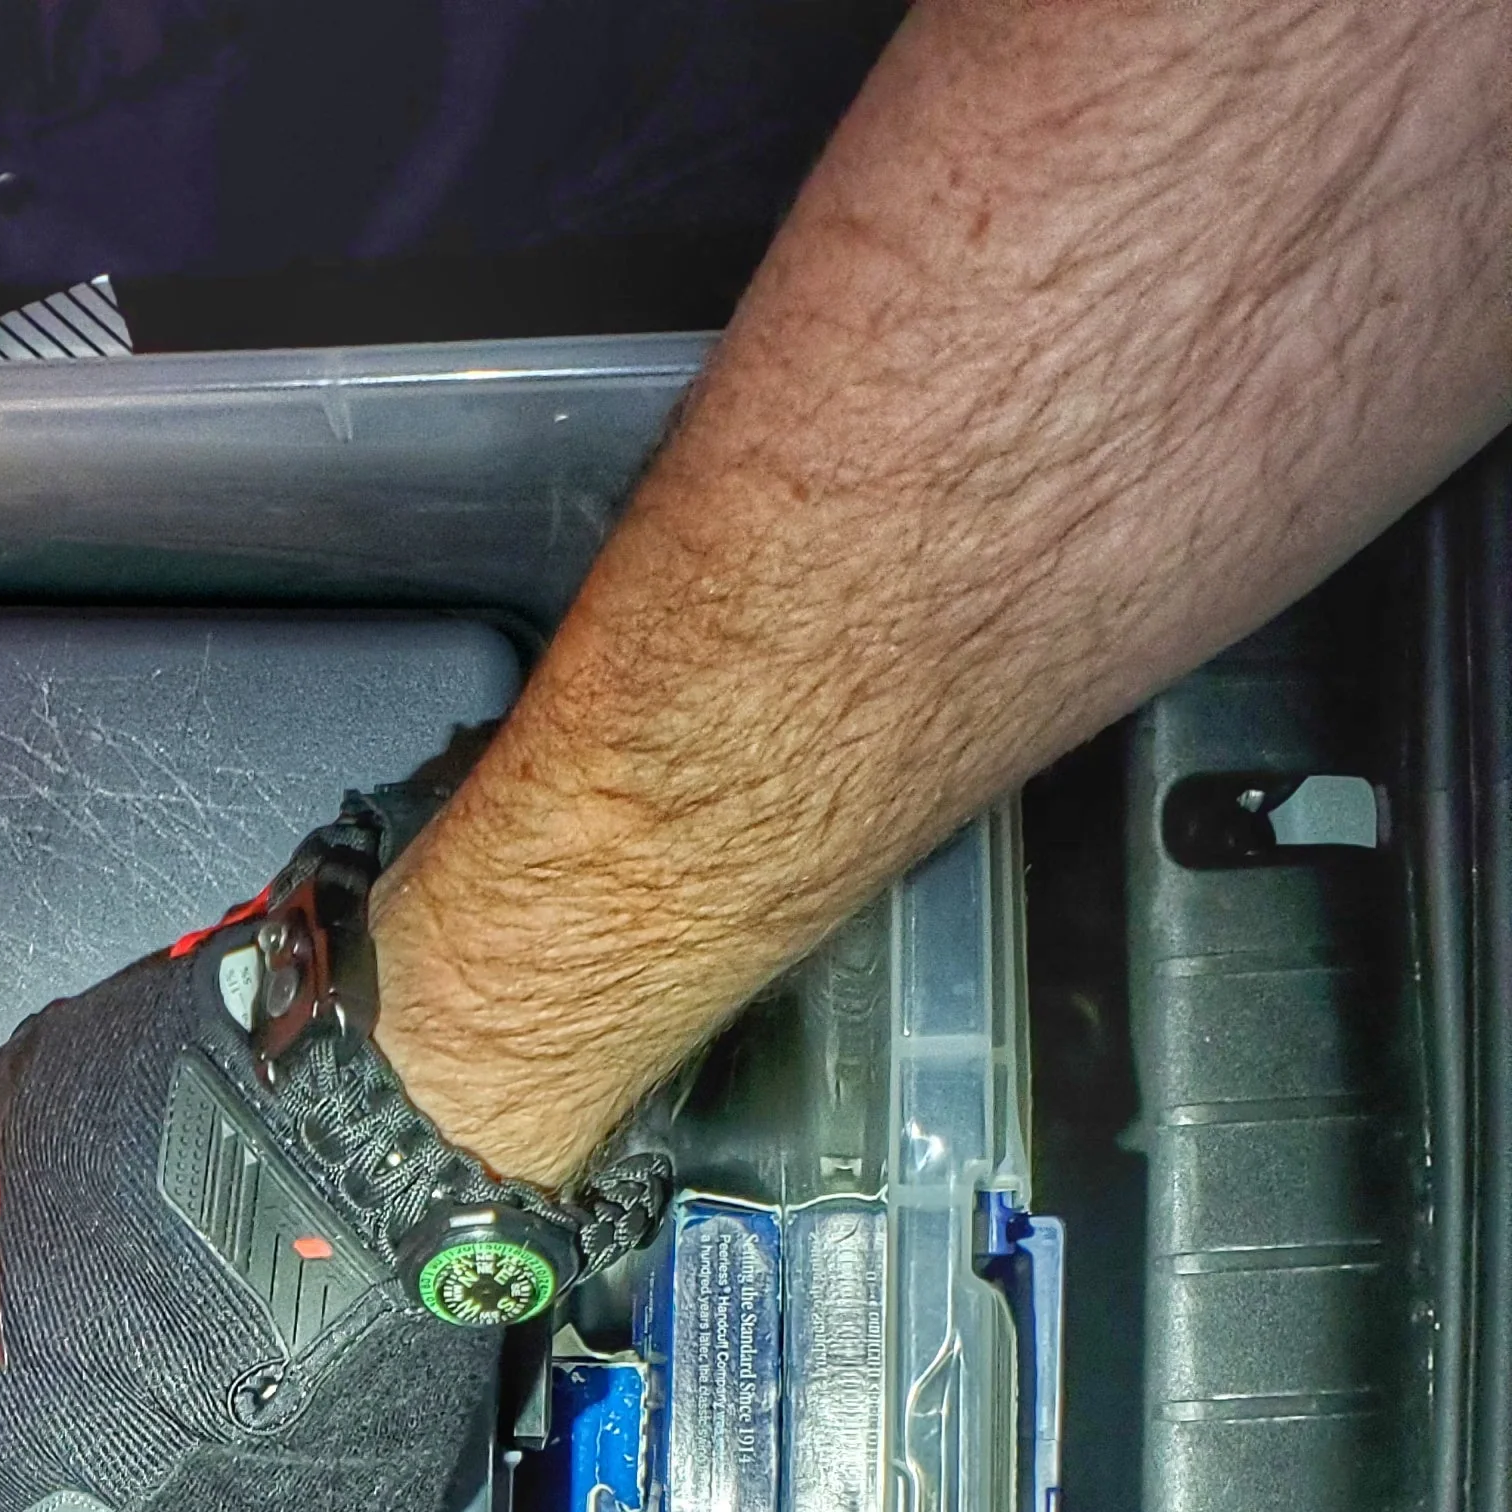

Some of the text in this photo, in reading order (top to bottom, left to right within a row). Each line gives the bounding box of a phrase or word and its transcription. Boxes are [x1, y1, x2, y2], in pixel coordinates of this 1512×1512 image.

[701, 1234, 710, 1242] a
[700, 1245, 712, 1293] hundred
[698, 1297, 710, 1329] years
[715, 1296, 729, 1349] Handcuff
[699, 1332, 711, 1360] later,
[738, 1234, 758, 1463] Setting the Standard Since 1914
[699, 1365, 711, 1382] the
[713, 1352, 728, 1409] Company
[698, 1386, 710, 1425] classic
